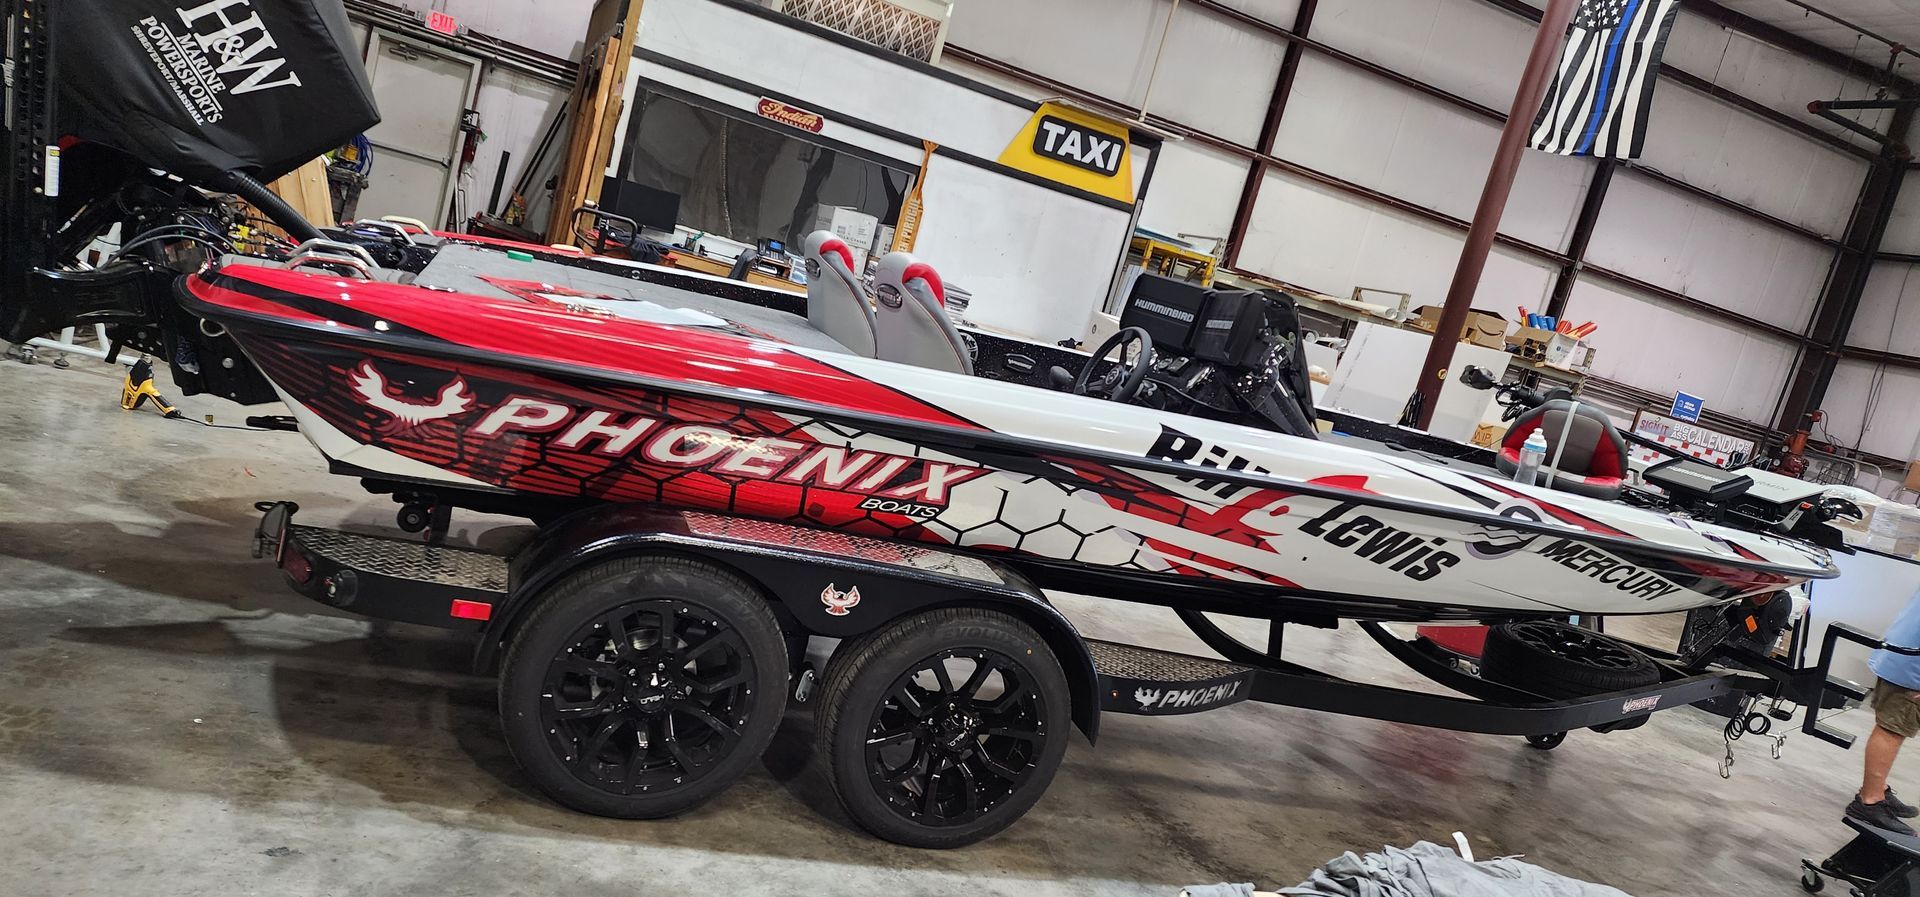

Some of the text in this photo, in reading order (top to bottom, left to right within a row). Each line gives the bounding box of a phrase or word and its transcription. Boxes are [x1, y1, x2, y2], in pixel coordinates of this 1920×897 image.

[430, 12, 454, 34] EXIT
[139, 15, 223, 123] POWERSPORTS
[176, 33, 226, 94] MARINE
[761, 102, 817, 127] Indian
[1042, 120, 1121, 171] TAXI
[1134, 297, 1195, 323] HUMMINBIRD
[1670, 431, 1688, 441] ASS
[1673, 424, 1690, 434] BIG
[1687, 428, 1745, 454] CALENDAR
[471, 394, 985, 503] PHOENIX
[861, 499, 940, 517] BOATS
[1298, 501, 1461, 581] Lewis
[1536, 538, 1682, 600] MERCURY
[1158, 681, 1242, 708] PHOENIX
